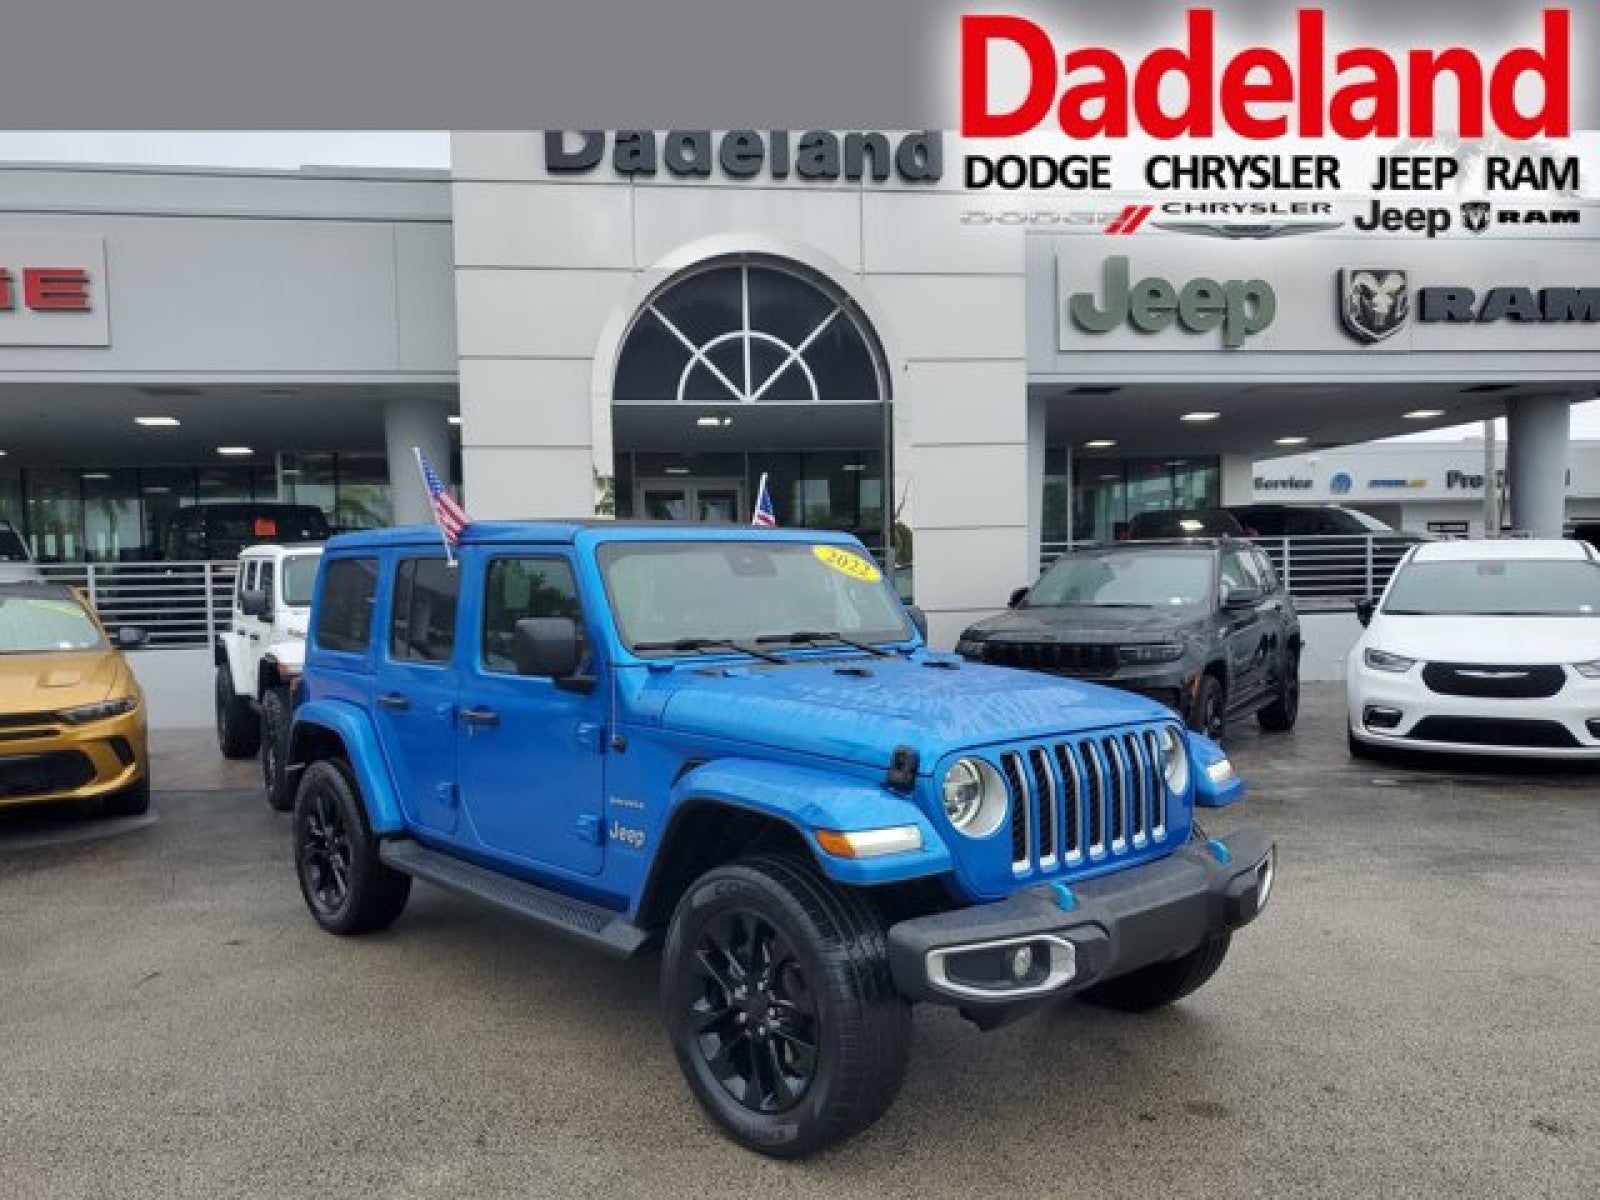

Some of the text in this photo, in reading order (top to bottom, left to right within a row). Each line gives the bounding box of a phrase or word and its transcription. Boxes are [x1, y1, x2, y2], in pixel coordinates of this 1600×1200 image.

[544, 130, 943, 185] Dadeland
[1070, 256, 1276, 348] Jeep
[1417, 286, 1600, 324] RAM
[609, 820, 646, 849] Jeep
